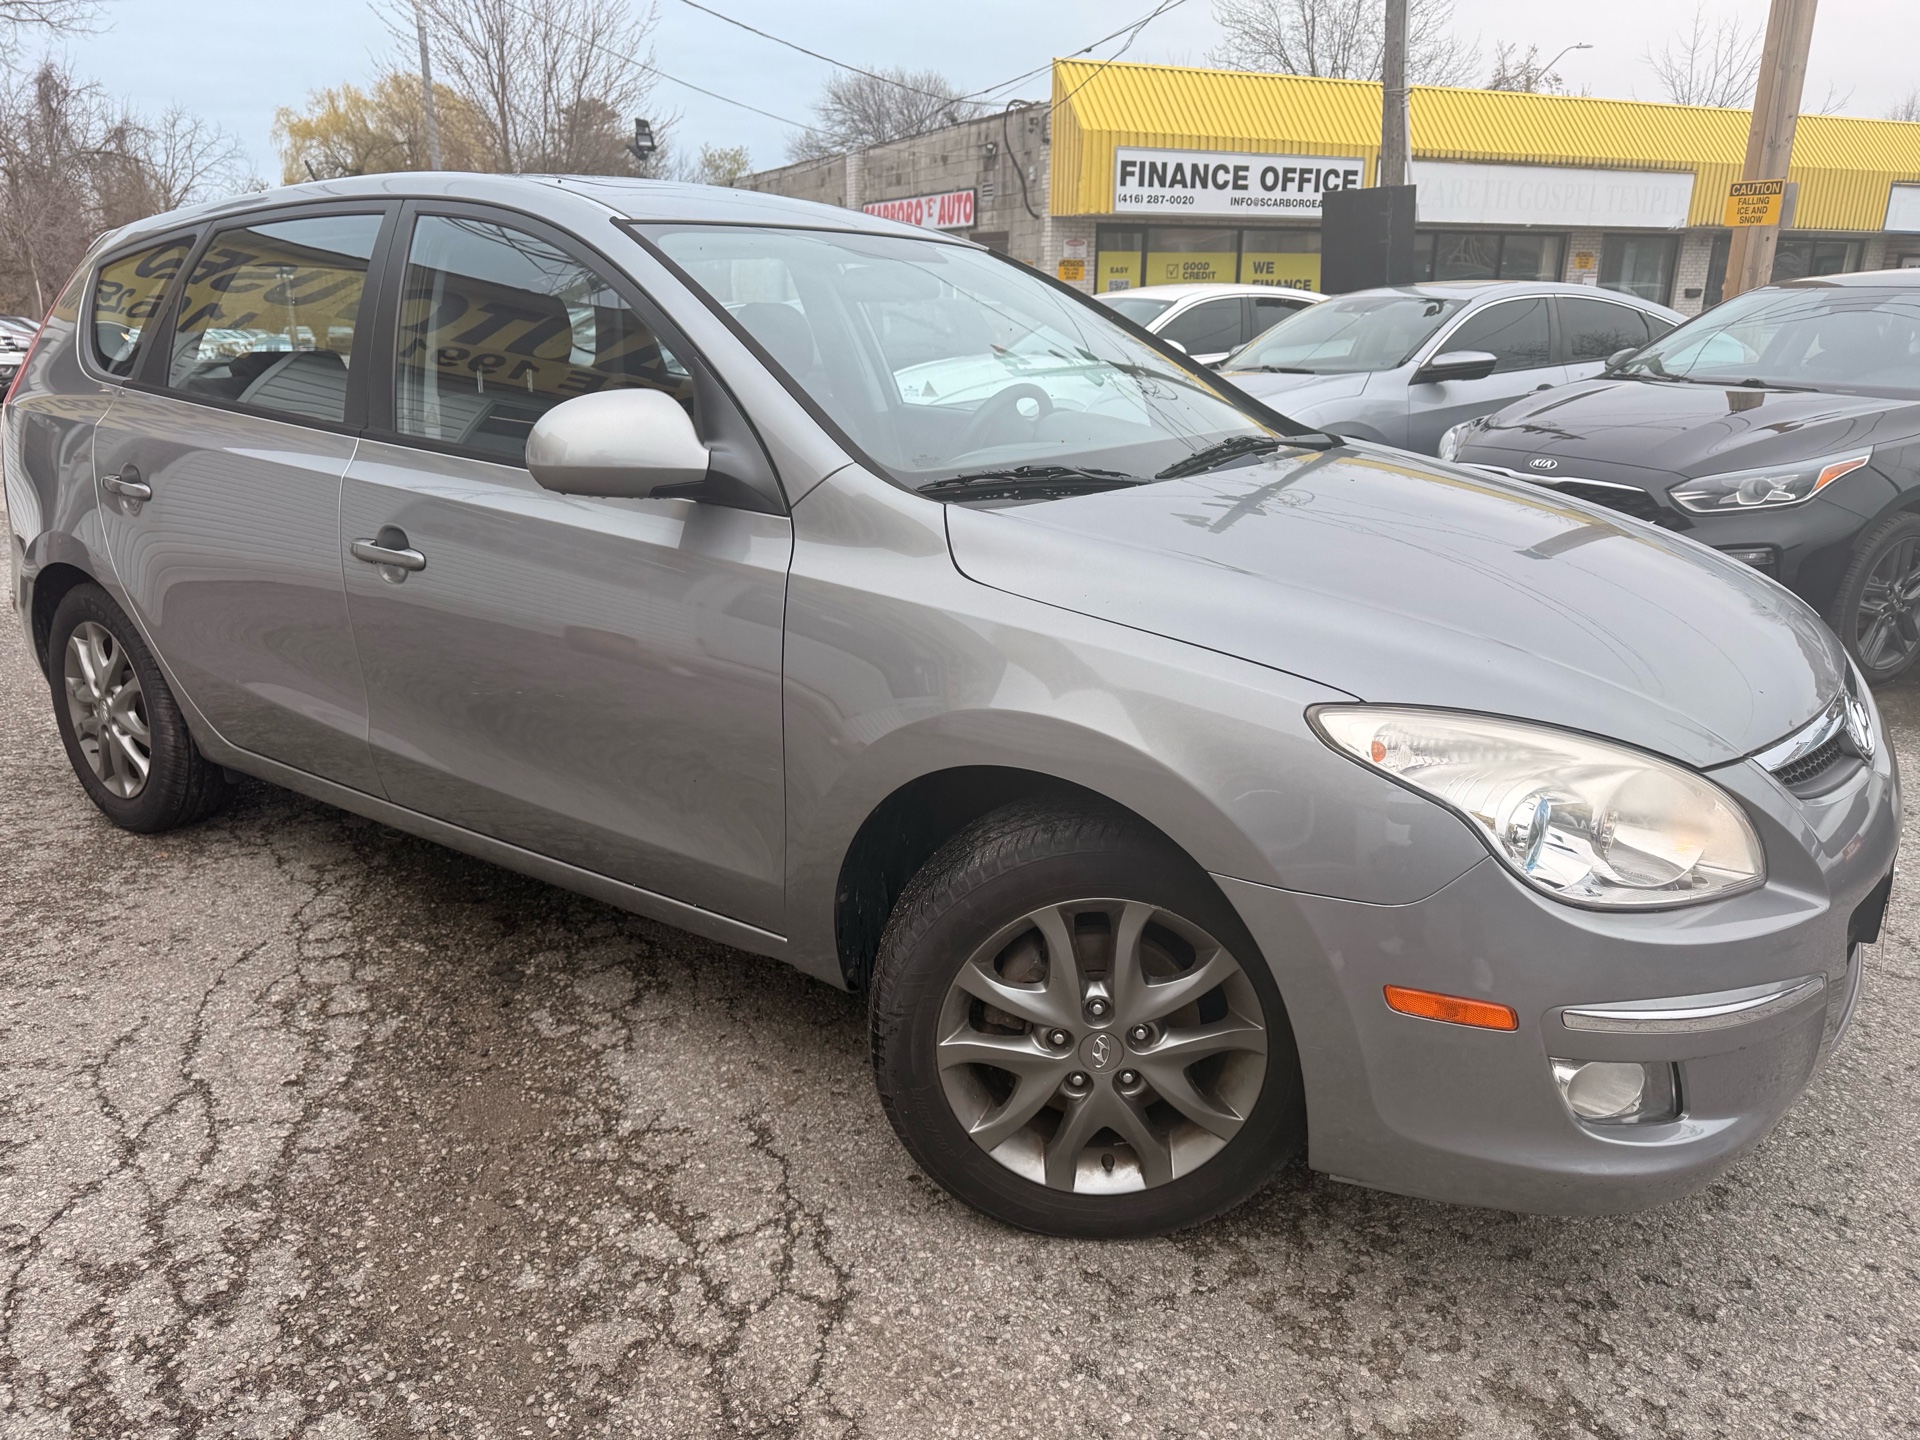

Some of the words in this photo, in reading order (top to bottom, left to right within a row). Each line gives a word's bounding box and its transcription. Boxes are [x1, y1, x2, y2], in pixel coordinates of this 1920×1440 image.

[1119, 160, 1250, 191] FINANCE
[1260, 166, 1359, 193] OFFICE
[1732, 182, 1781, 195] CAUTION
[1118, 194, 1143, 204] (416)
[1147, 195, 1195, 205] 287-0020
[1517, 179, 1600, 214] GOSPEL
[1607, 185, 1688, 215] TEMPLE
[1737, 196, 1770, 206] FALLING
[937, 192, 973, 225] AUTO
[1737, 206, 1750, 216] ICE
[1750, 206, 1768, 215] AND
[1739, 215, 1763, 224] SNOW
[1110, 266, 1129, 274] EASY
[1183, 262, 1210, 271] GOOD
[1253, 262, 1275, 274] WE
[1182, 271, 1216, 280] CREDIT
[1532, 458, 1553, 469] KIA
